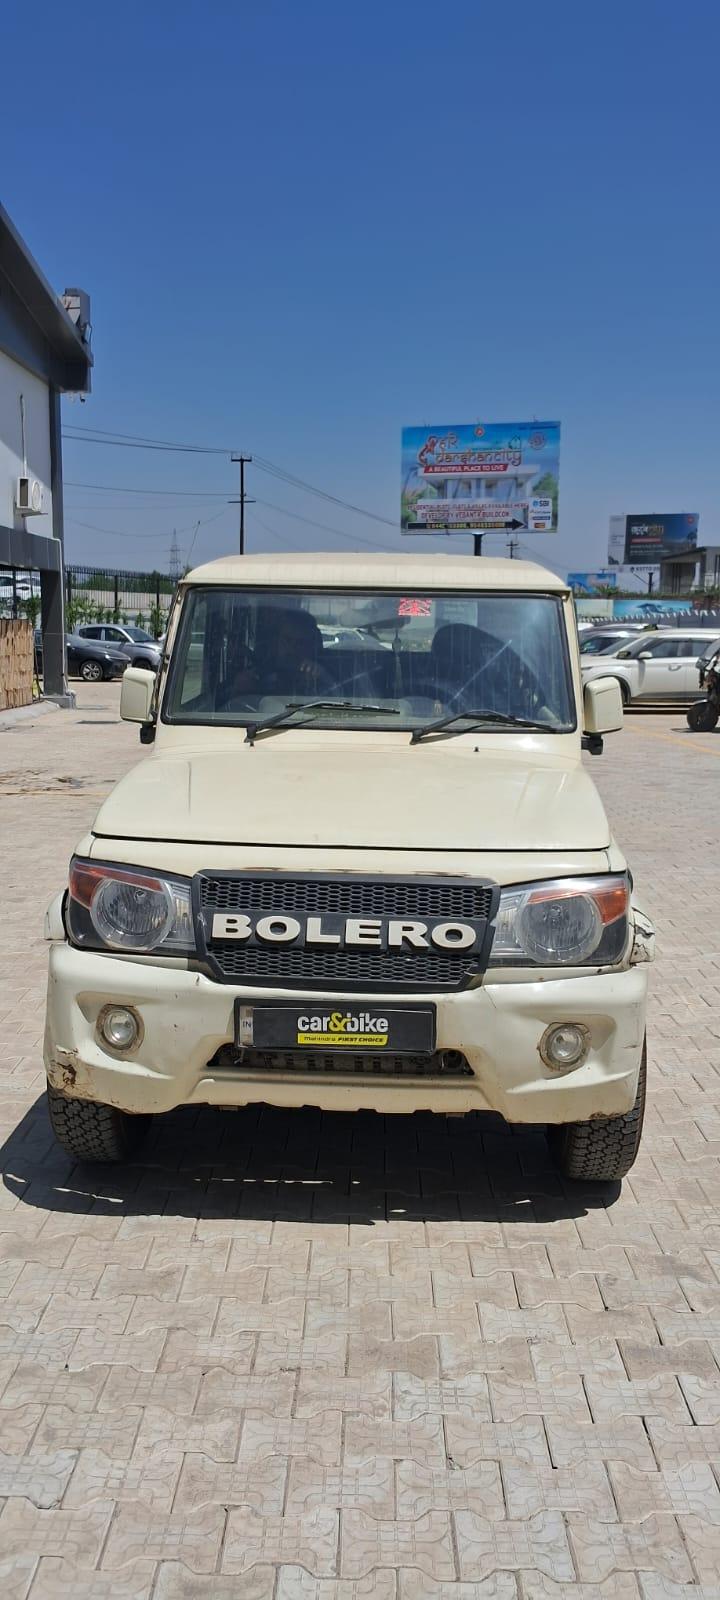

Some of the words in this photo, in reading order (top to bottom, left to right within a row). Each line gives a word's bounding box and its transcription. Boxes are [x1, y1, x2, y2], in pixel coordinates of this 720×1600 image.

[435, 449, 522, 466] darshancity
[211, 913, 476, 950] BOLERO
[297, 1012, 389, 1032] car&bike
